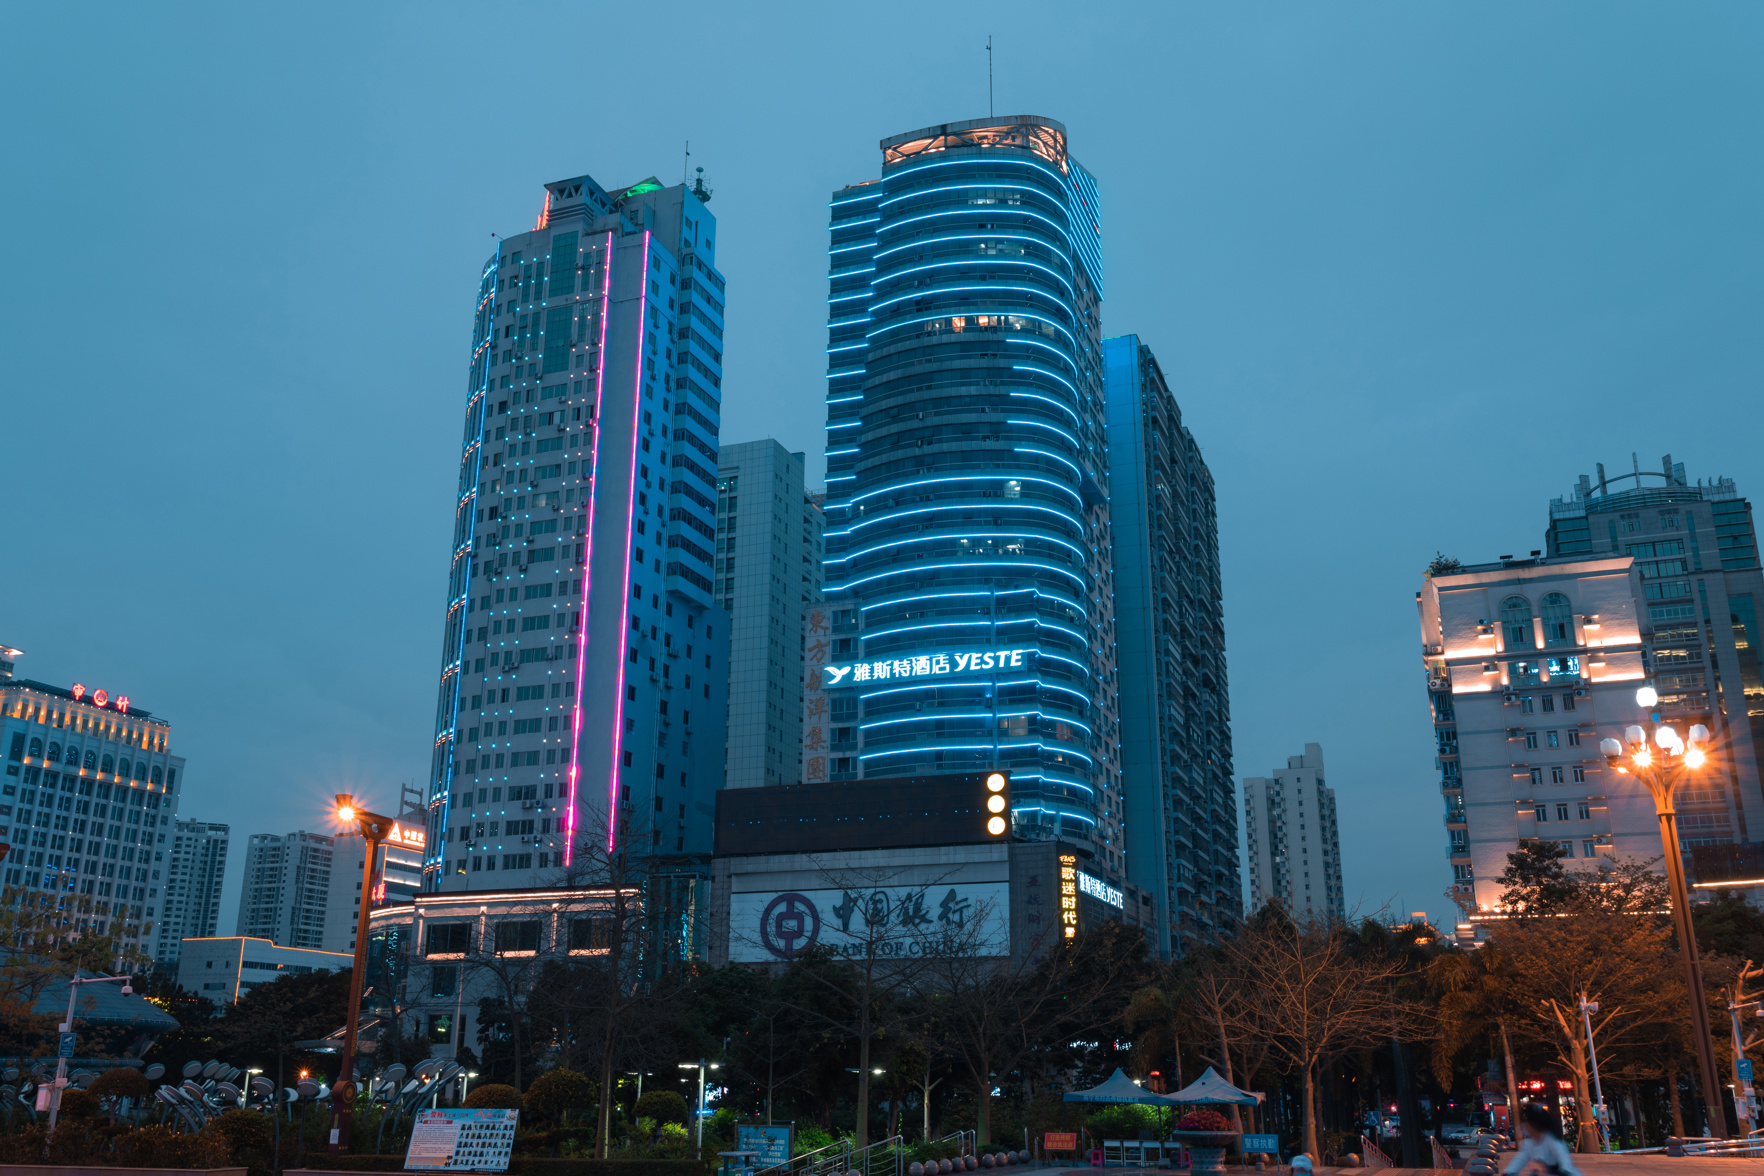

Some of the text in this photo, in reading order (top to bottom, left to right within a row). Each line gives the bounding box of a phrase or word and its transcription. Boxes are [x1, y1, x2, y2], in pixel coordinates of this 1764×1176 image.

[853, 649, 1023, 682] 雅斯特酒店 YESTE
[404, 829, 425, 842] 中国农
[1106, 886, 1123, 910] YESTE
[881, 941, 903, 956] OF
[1244, 1137, 1276, 1149] 警察执勤
